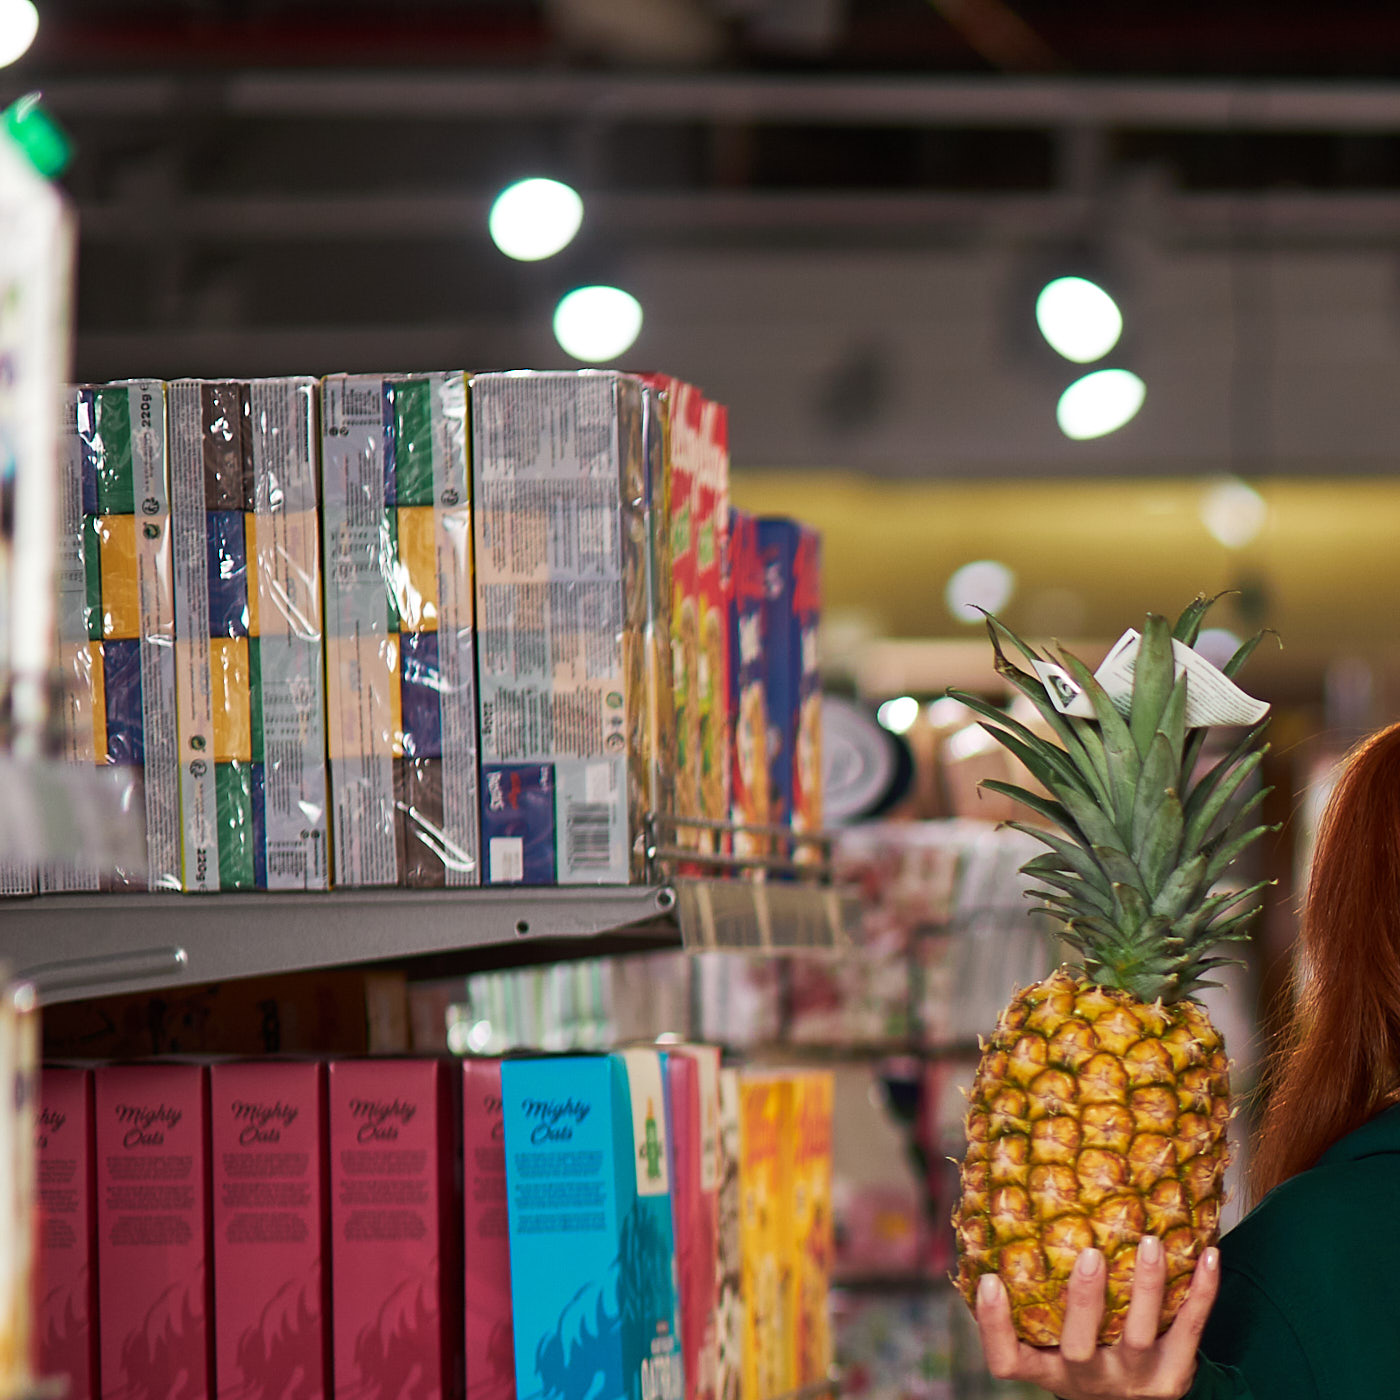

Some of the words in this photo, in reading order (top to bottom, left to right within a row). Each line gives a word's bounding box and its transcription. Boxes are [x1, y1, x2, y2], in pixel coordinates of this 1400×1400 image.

[140, 394, 152, 427] 220g
[196, 848, 207, 882] 220g
[115, 1103, 183, 1127] Mighty
[231, 1099, 298, 1127] Mighty
[349, 1097, 417, 1124] Mighty
[521, 1097, 592, 1124] Mighty
[123, 1127, 164, 1149] Oats
[239, 1124, 281, 1147] Oats
[356, 1122, 399, 1144] Oats
[530, 1123, 573, 1146] Oats
